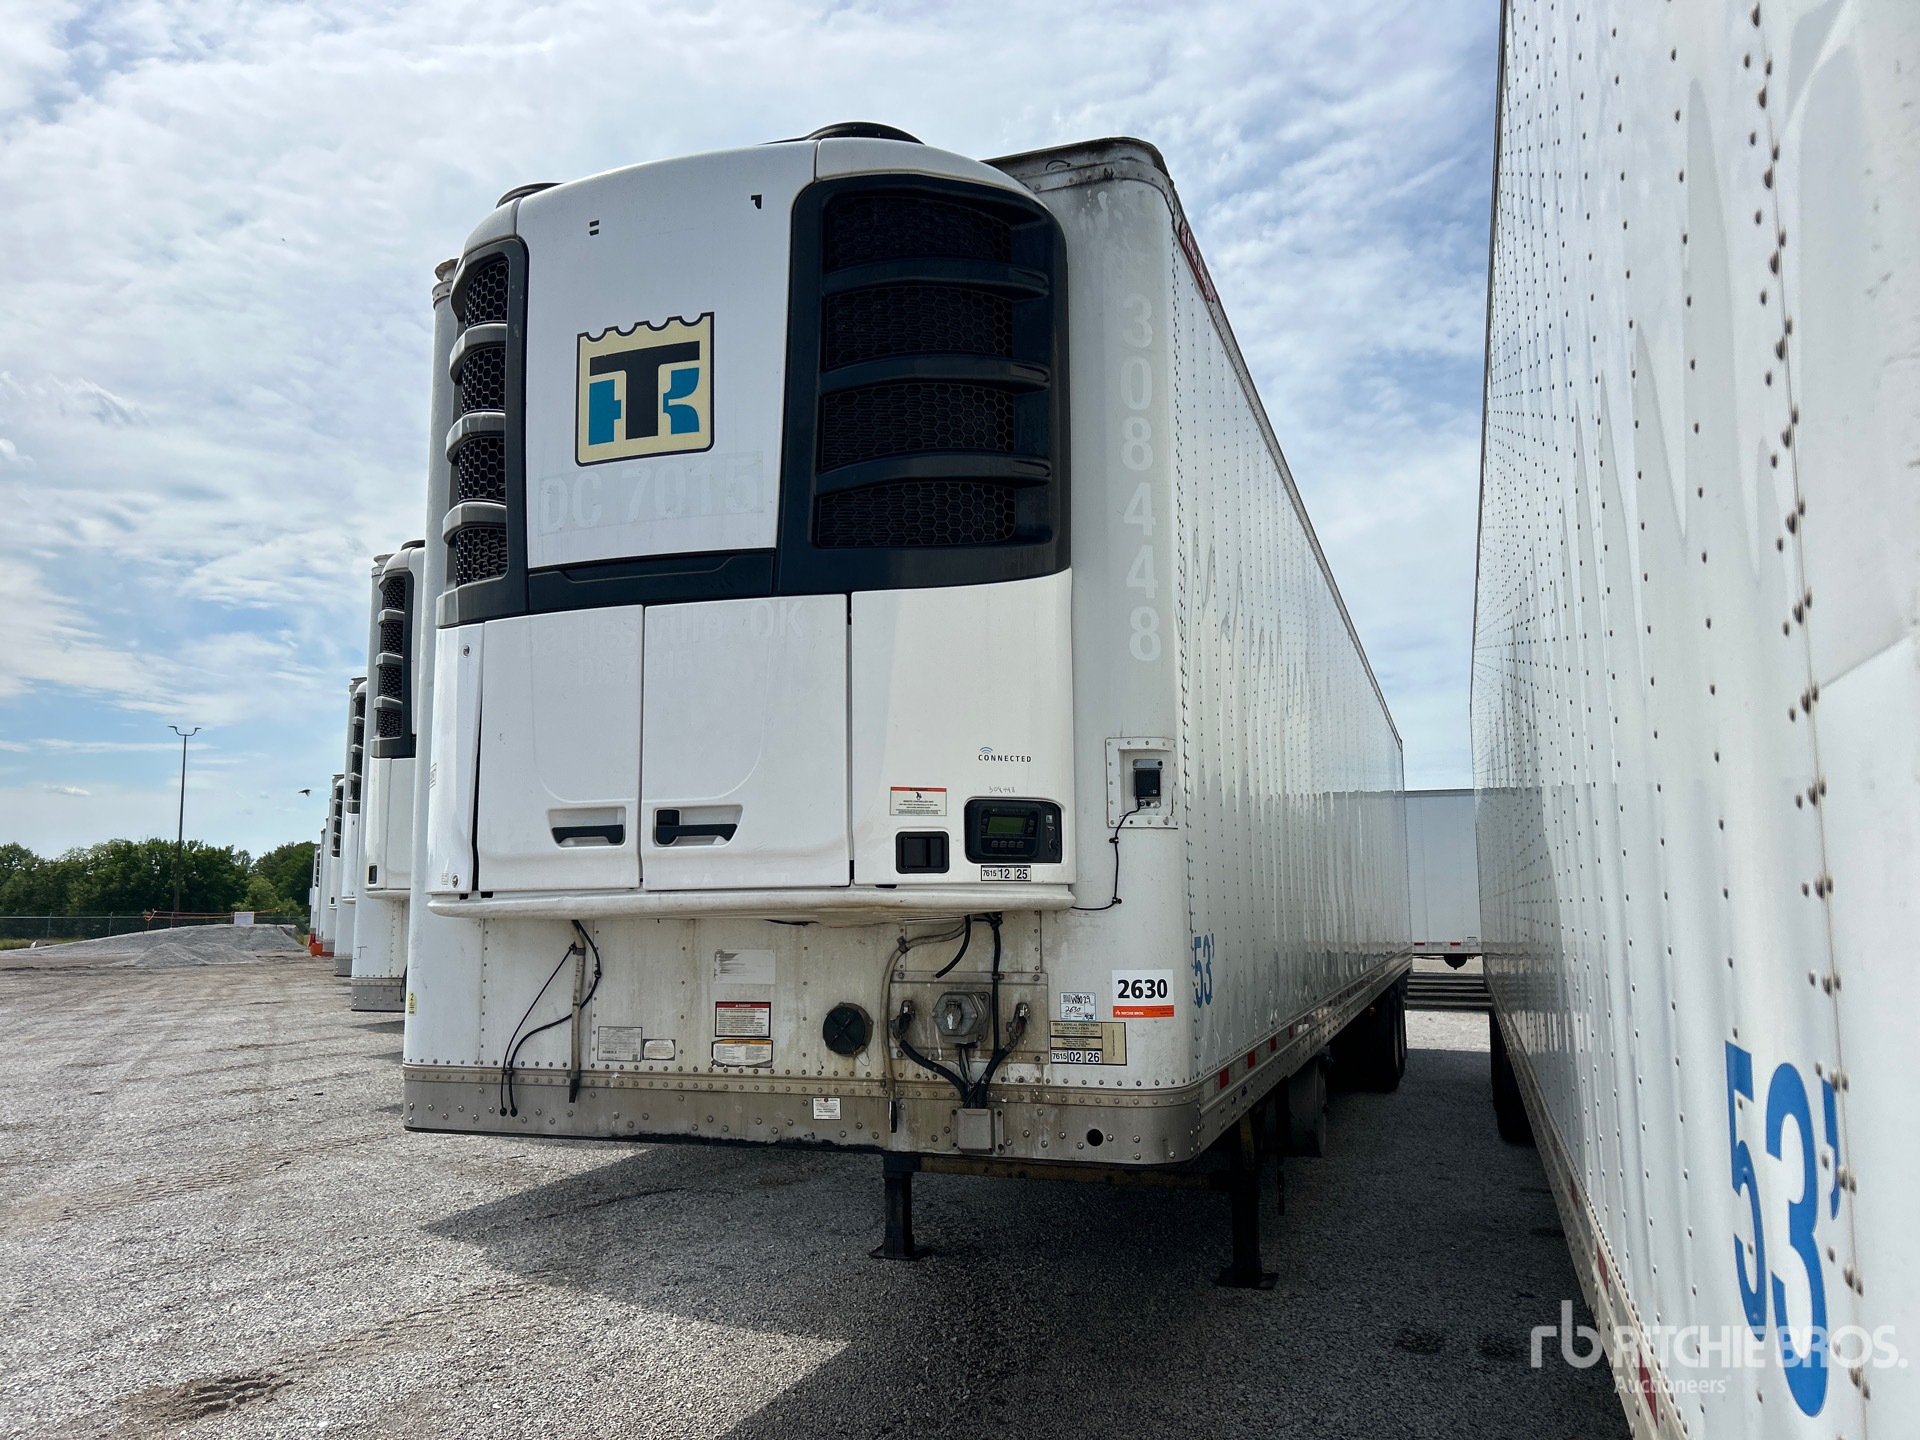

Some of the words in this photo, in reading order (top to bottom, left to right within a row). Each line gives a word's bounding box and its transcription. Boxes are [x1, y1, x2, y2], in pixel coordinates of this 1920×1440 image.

[541, 471, 601, 532] DC
[621, 456, 760, 521] 7015
[750, 600, 804, 638] OK
[978, 754, 1032, 763] CONNECTED
[999, 868, 1010, 879] 12
[1016, 868, 1028, 880] 25
[1194, 933, 1214, 1008] 53'
[1117, 978, 1168, 999] 2630
[1069, 1051, 1082, 1062] 02
[1087, 1052, 1100, 1063] 26
[1725, 1040, 1841, 1418] 53'
